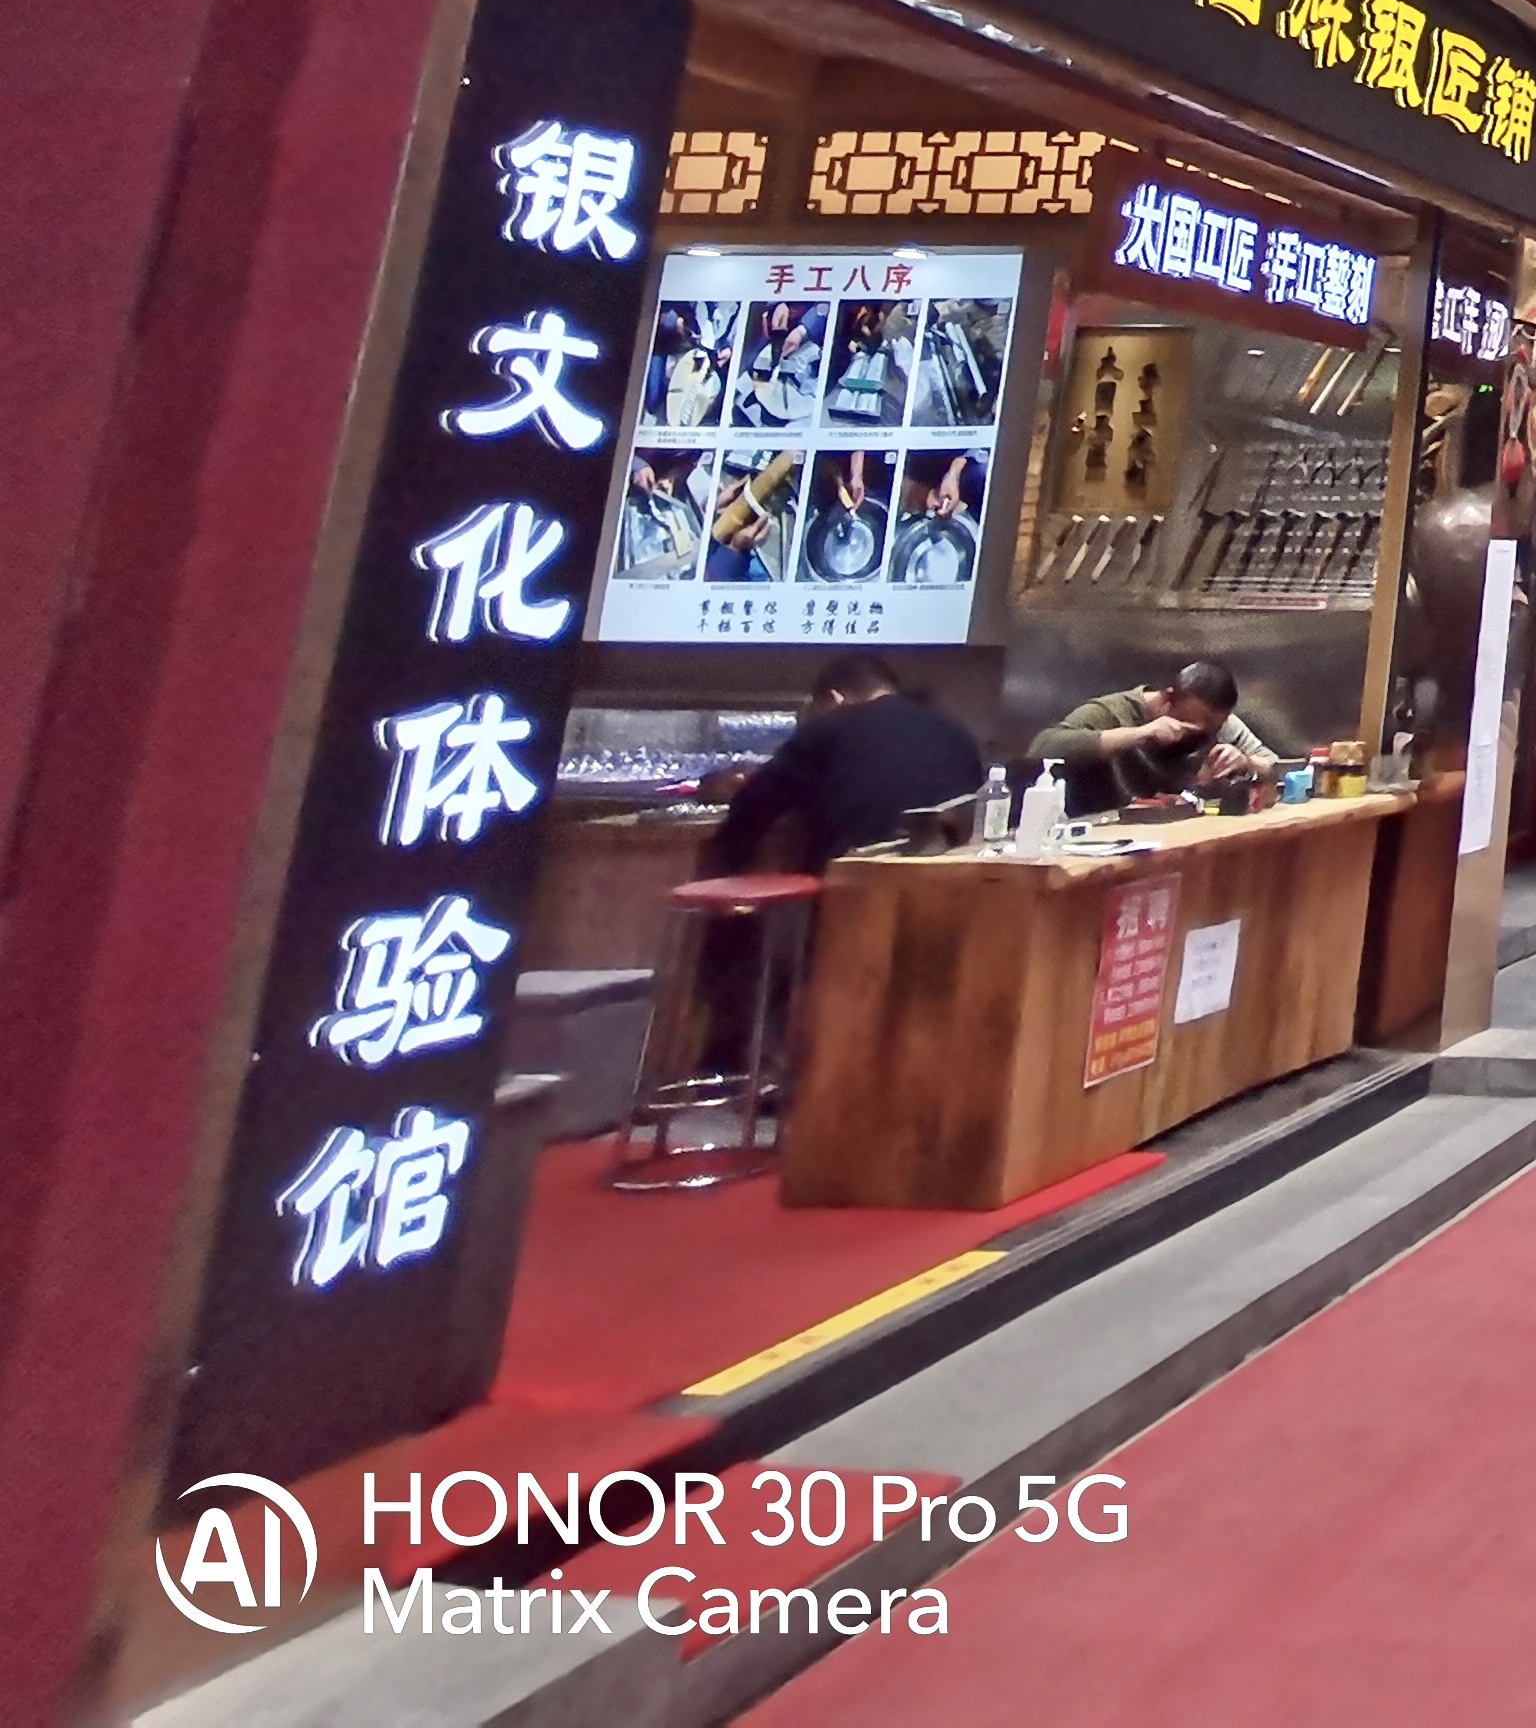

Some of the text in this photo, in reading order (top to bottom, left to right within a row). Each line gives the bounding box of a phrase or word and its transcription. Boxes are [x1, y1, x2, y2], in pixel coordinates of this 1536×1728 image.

[765, 264, 913, 294] 手工八序
[1114, 183, 1259, 292] 大国工匠
[276, 118, 642, 1290] 银文化体验馆
